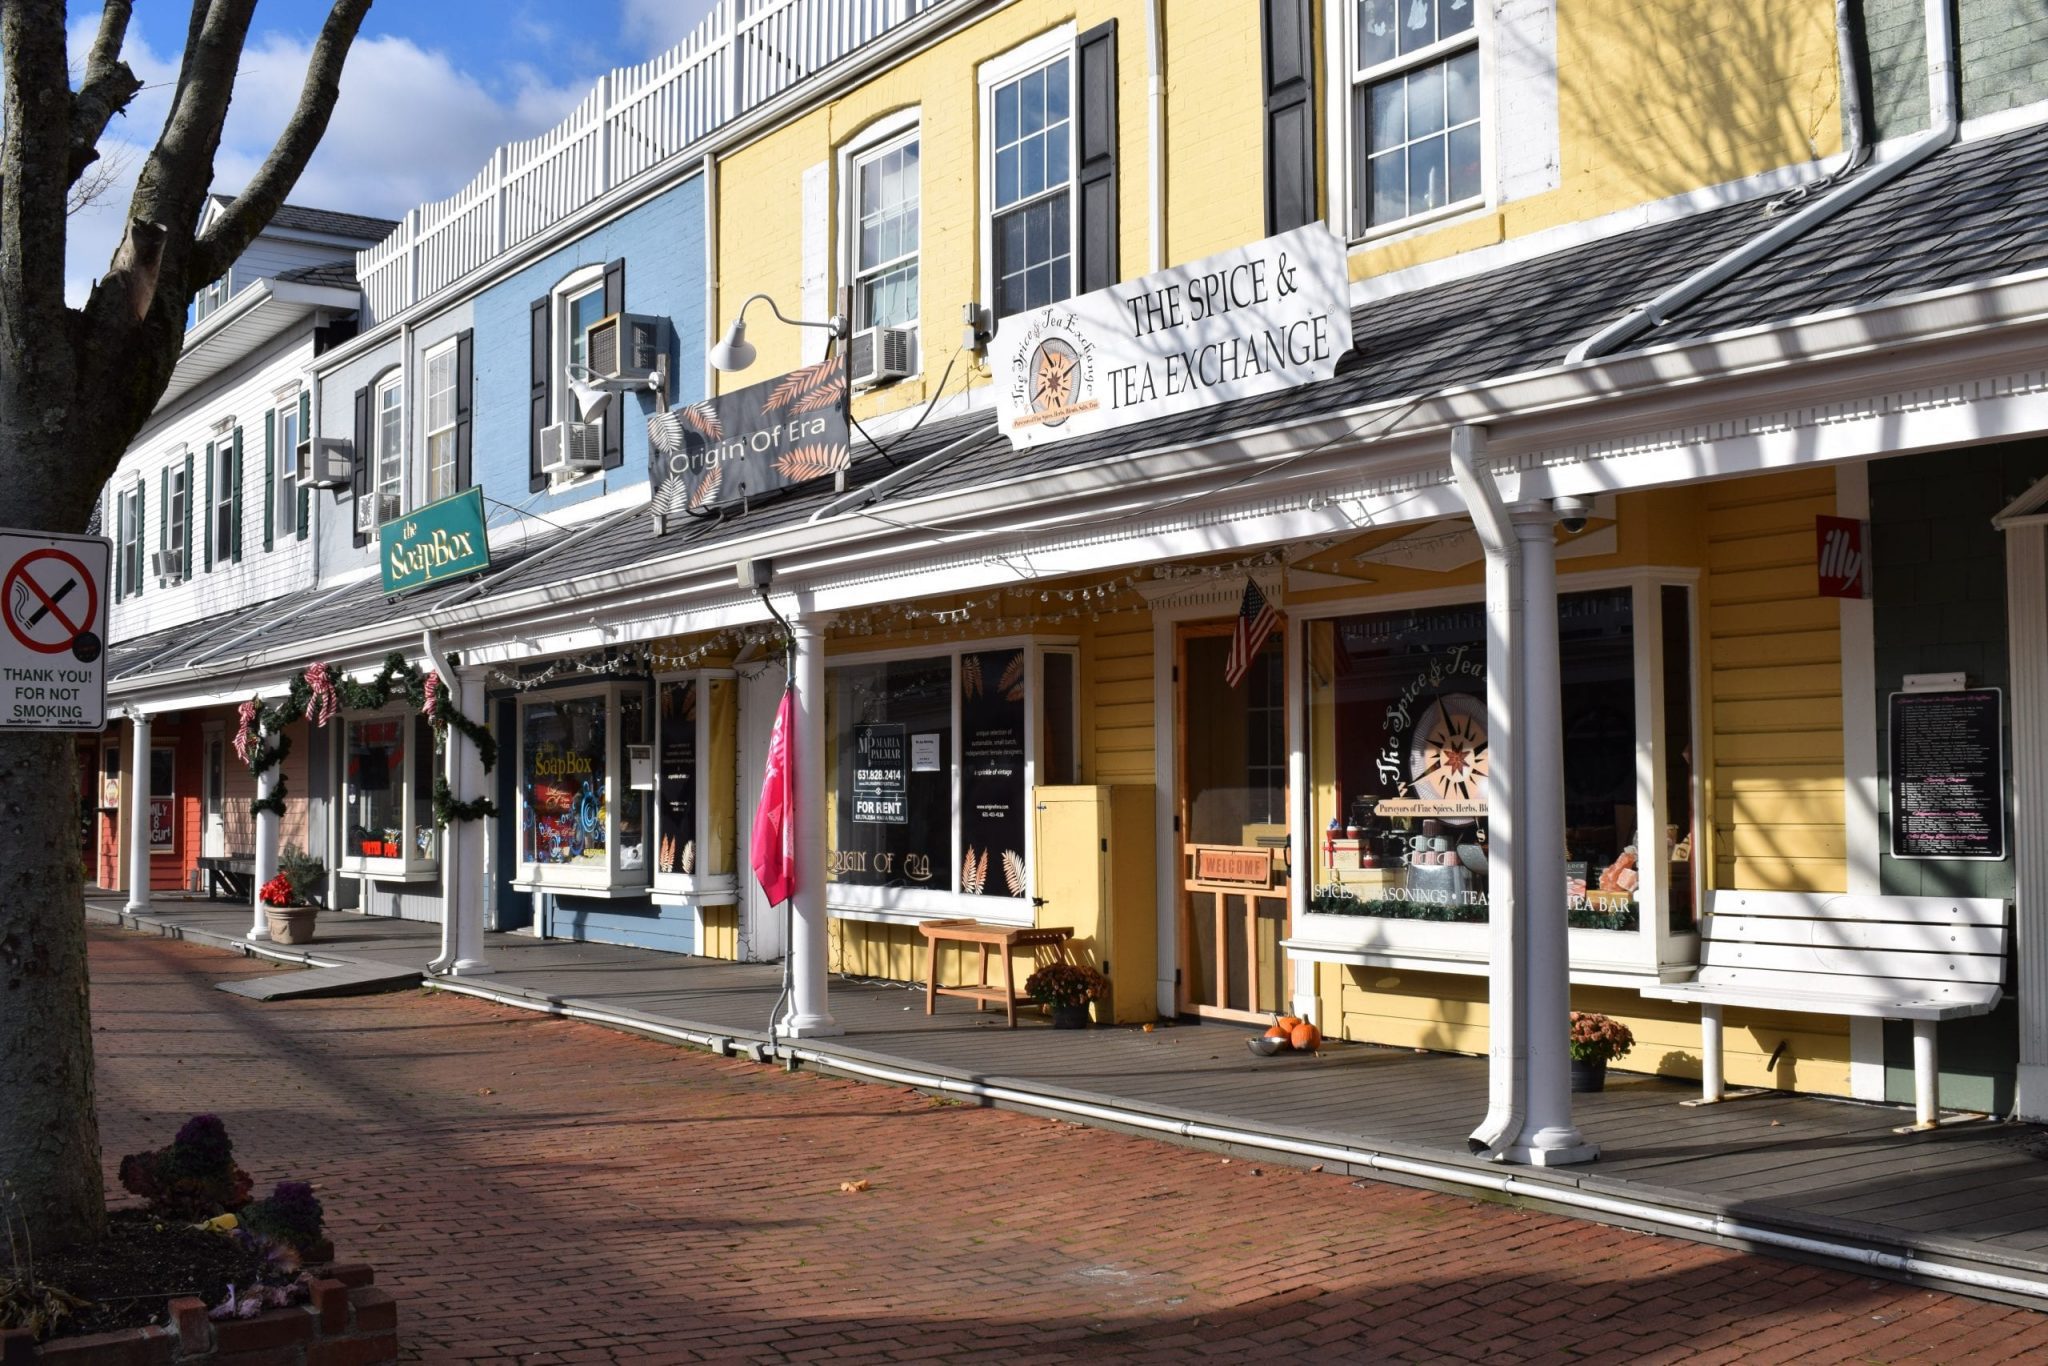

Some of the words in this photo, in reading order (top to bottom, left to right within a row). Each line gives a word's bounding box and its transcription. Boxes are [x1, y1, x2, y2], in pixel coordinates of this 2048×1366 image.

[1127, 285, 1184, 337] THE
[1188, 259, 1268, 321] SPICE
[1276, 252, 1298, 297] &
[1041, 308, 1062, 328] Tea
[1012, 330, 1033, 373] Spice
[1064, 313, 1097, 396] Exchange
[1107, 361, 1158, 409] TEA
[1165, 315, 1330, 397] EXCHANGE
[1012, 375, 1028, 408] The
[669, 439, 745, 474] Origin
[751, 424, 781, 452] Of
[789, 417, 826, 442] Era
[403, 521, 417, 540] the
[391, 530, 474, 580] SoapBox
[1820, 528, 1861, 591] illy
[3, 668, 54, 682] THANK
[58, 670, 92, 683] YOU!
[1445, 646, 1483, 677] Tea
[15, 687, 45, 700] FOR
[50, 688, 80, 701] NOT
[1383, 672, 1426, 732] Spice
[13, 704, 83, 718] SMOKING
[535, 751, 592, 782] SoapBox
[857, 770, 901, 780] 631.828.2414
[1376, 737, 1400, 785] The
[857, 801, 874, 813] FOR
[876, 802, 901, 814] RENT
[1380, 804, 1409, 814] Purveyors
[873, 852, 895, 873] OF
[904, 853, 933, 880] ERA
[1206, 858, 1261, 875] WELCOME
[1314, 884, 1354, 899] SPICES
[1599, 896, 1629, 913] BAR
